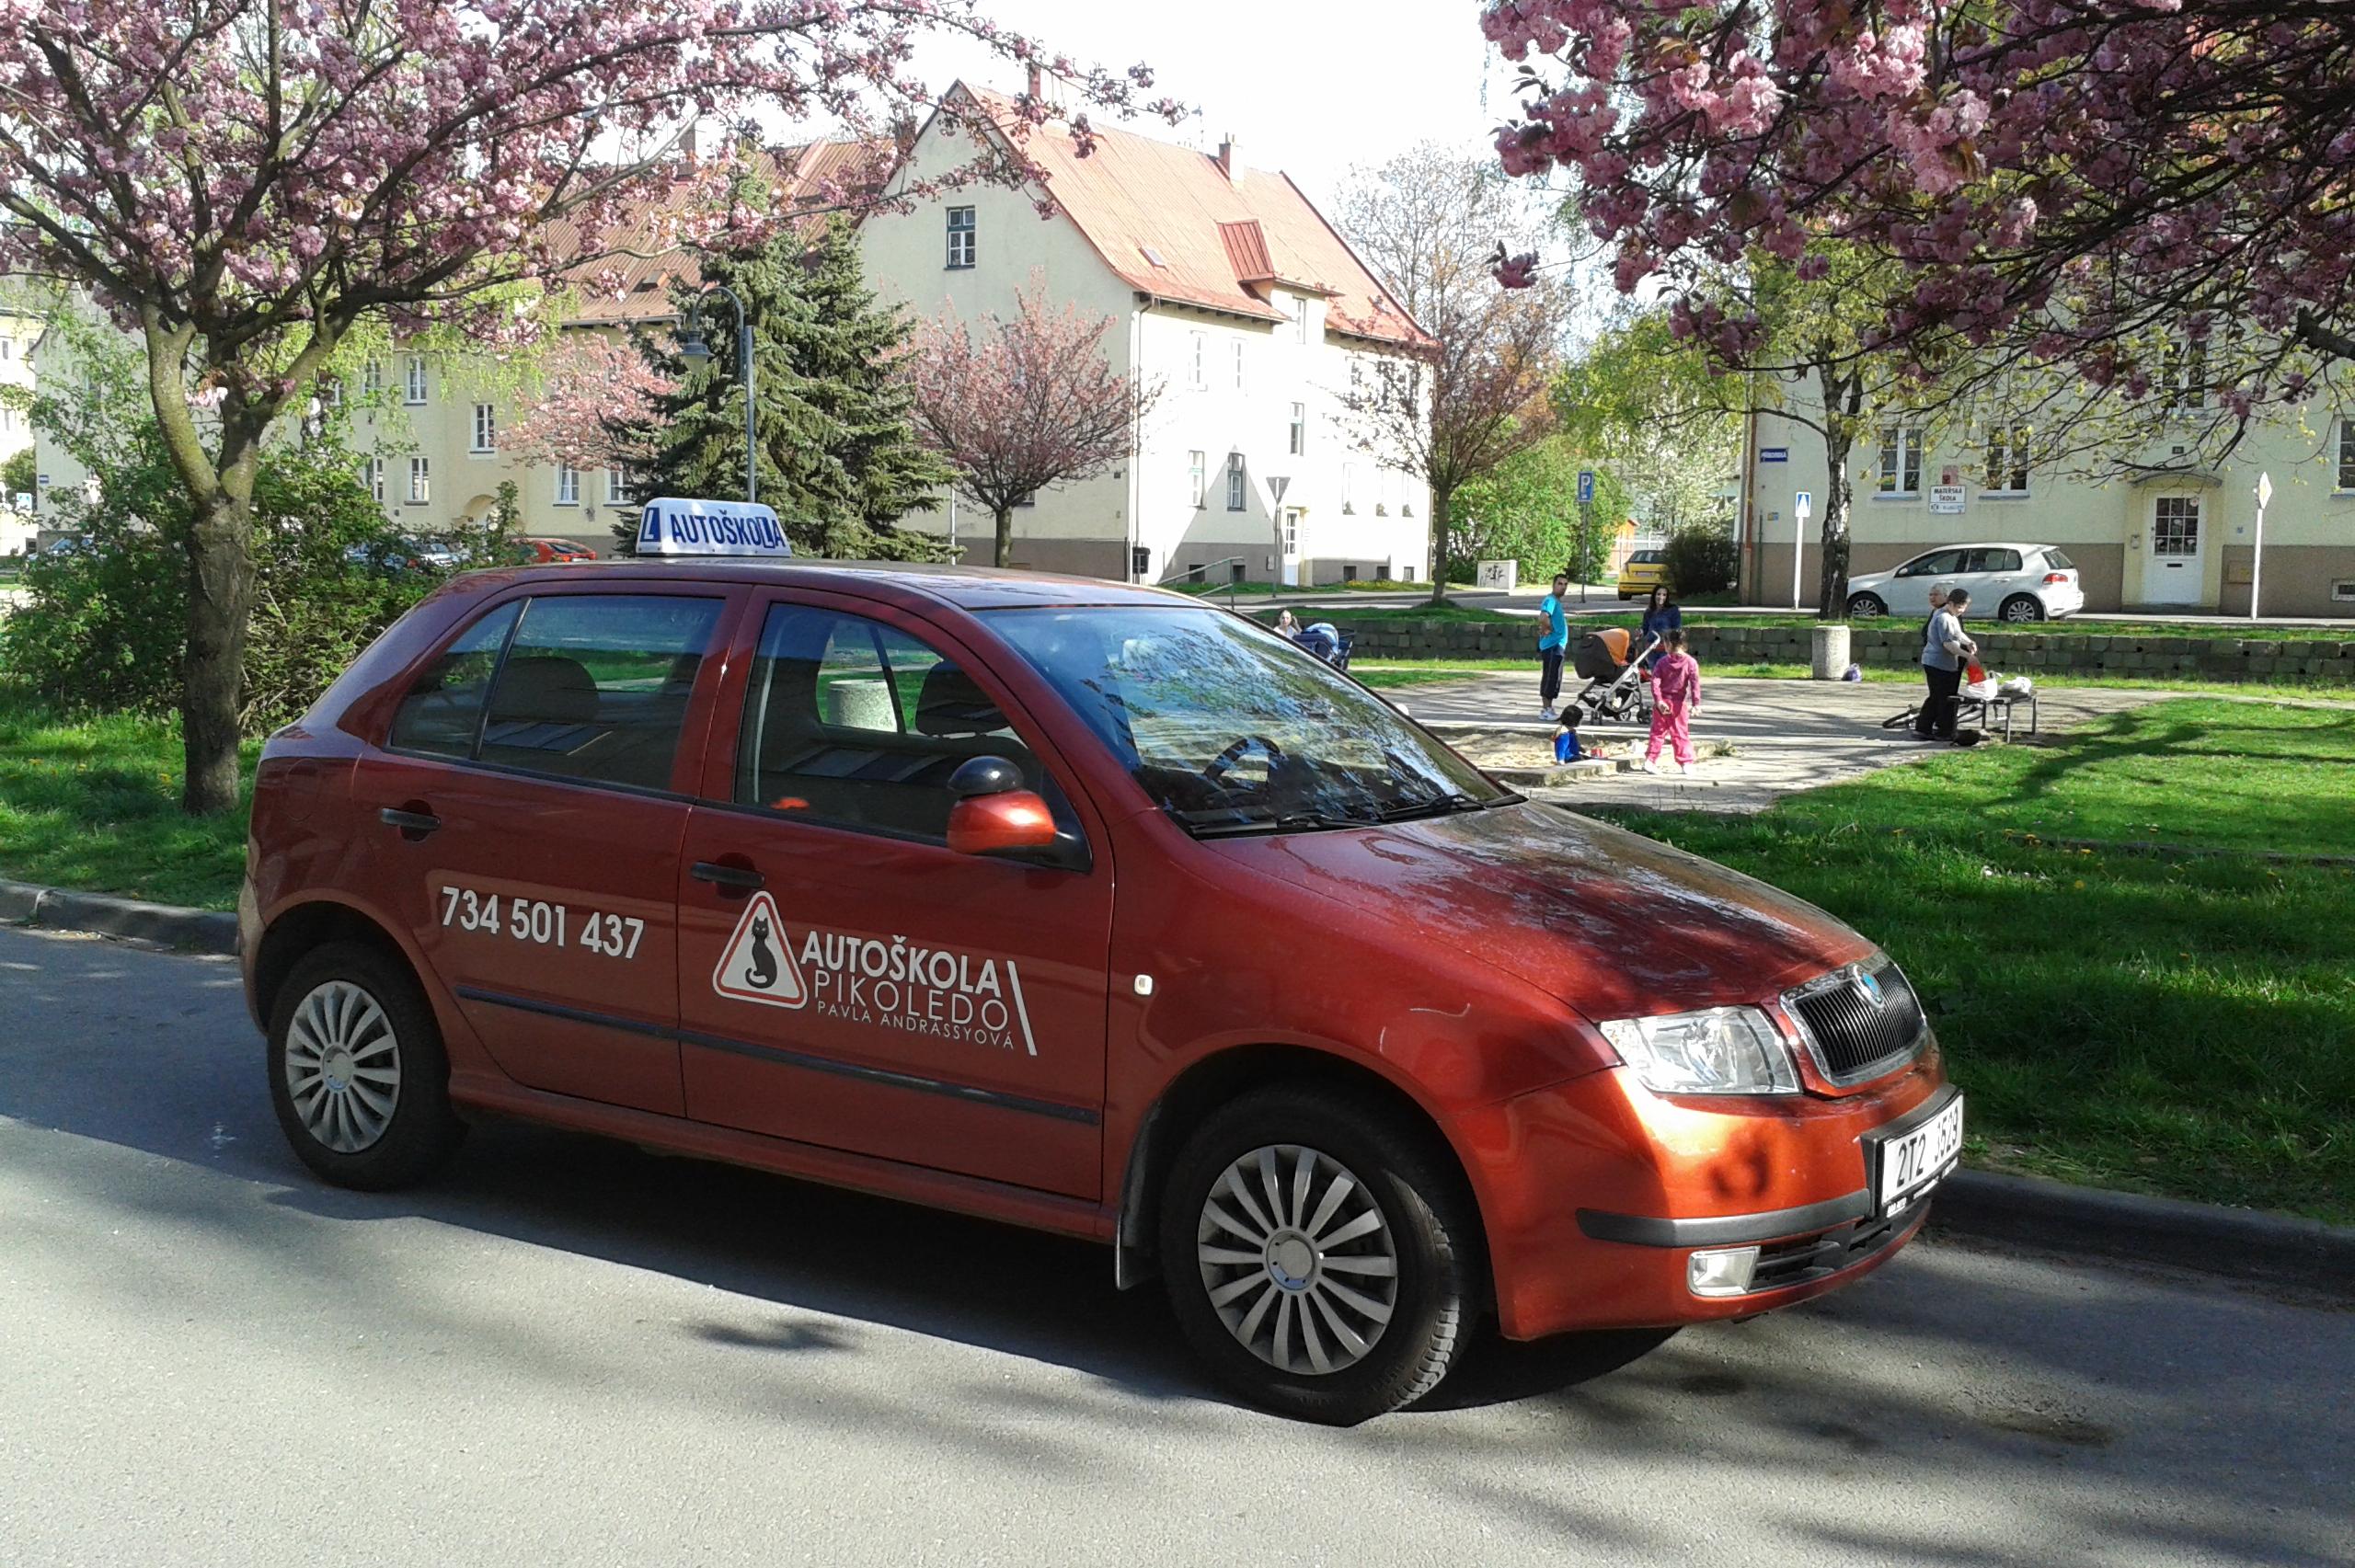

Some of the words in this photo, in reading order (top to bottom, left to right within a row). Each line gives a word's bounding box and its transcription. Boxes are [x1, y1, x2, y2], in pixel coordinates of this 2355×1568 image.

[1580, 475, 1591, 493] P
[643, 509, 655, 540] L
[670, 509, 786, 549] AUTOŠKOLA
[442, 887, 500, 934] 734
[511, 898, 565, 946] 501
[580, 911, 644, 958] 437
[800, 931, 1002, 998] AUTOŠKOLA
[815, 969, 1009, 1031] PIKOLEDO
[818, 1001, 872, 1024] PAVLA
[1897, 1132, 1926, 1188] 2T2
